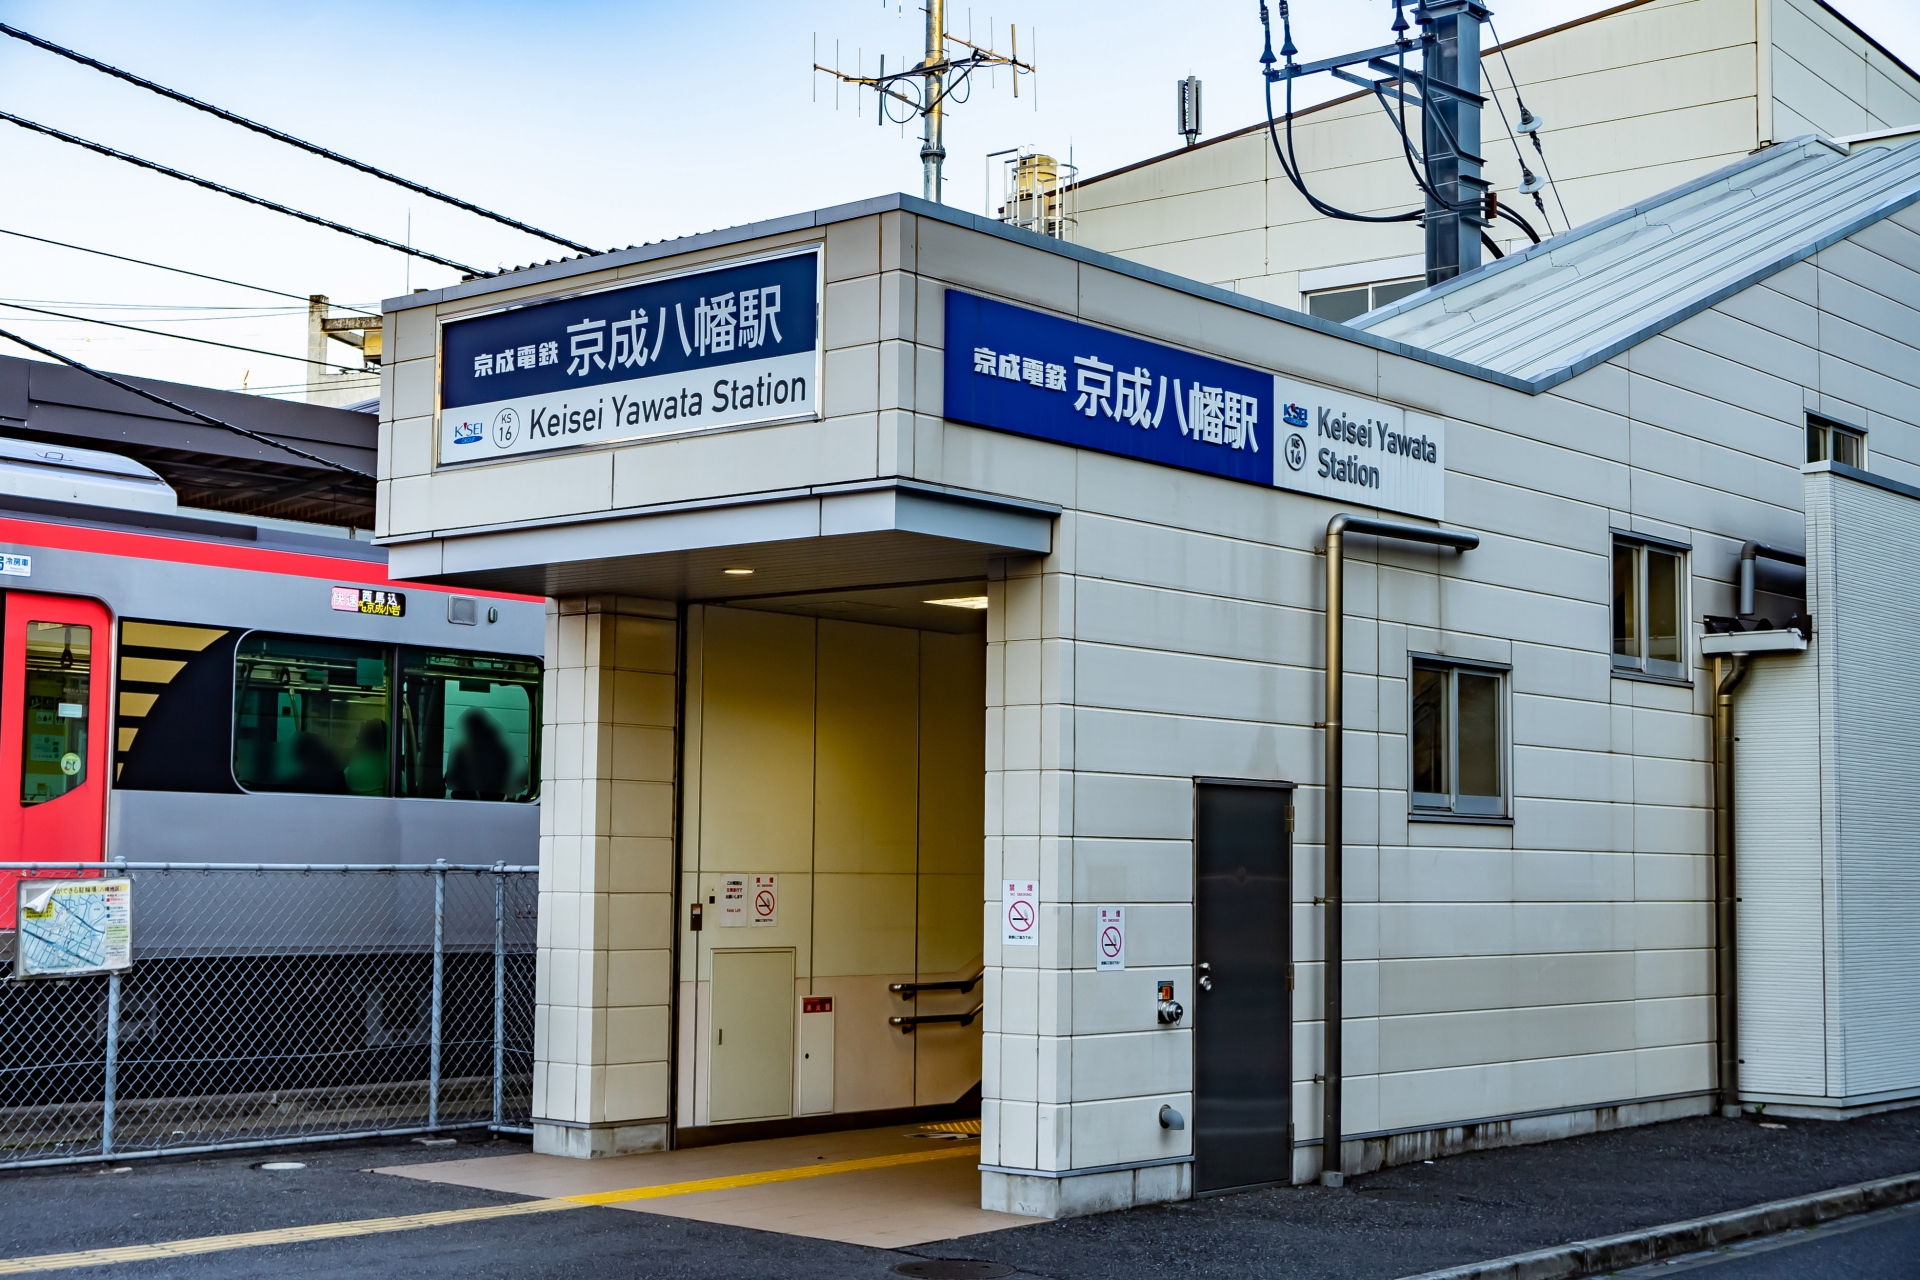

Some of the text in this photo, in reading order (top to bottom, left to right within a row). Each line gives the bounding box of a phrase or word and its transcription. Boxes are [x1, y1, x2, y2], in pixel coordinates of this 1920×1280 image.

[474, 284, 782, 377] 京成電鉄 京成八幡駅
[530, 372, 806, 440] Keisei Yawata Station
[973, 346, 1259, 454] 京成電鉄 京成八幡駅
[501, 413, 512, 424] KS
[499, 425, 512, 441] 16
[1317, 406, 1437, 464] Keisei Yawata
[1291, 437, 1301, 449] KS
[1290, 449, 1302, 465] 16
[1317, 447, 1380, 489] Station
[332, 591, 358, 608] 快速
[362, 590, 398, 606] 西馬込
